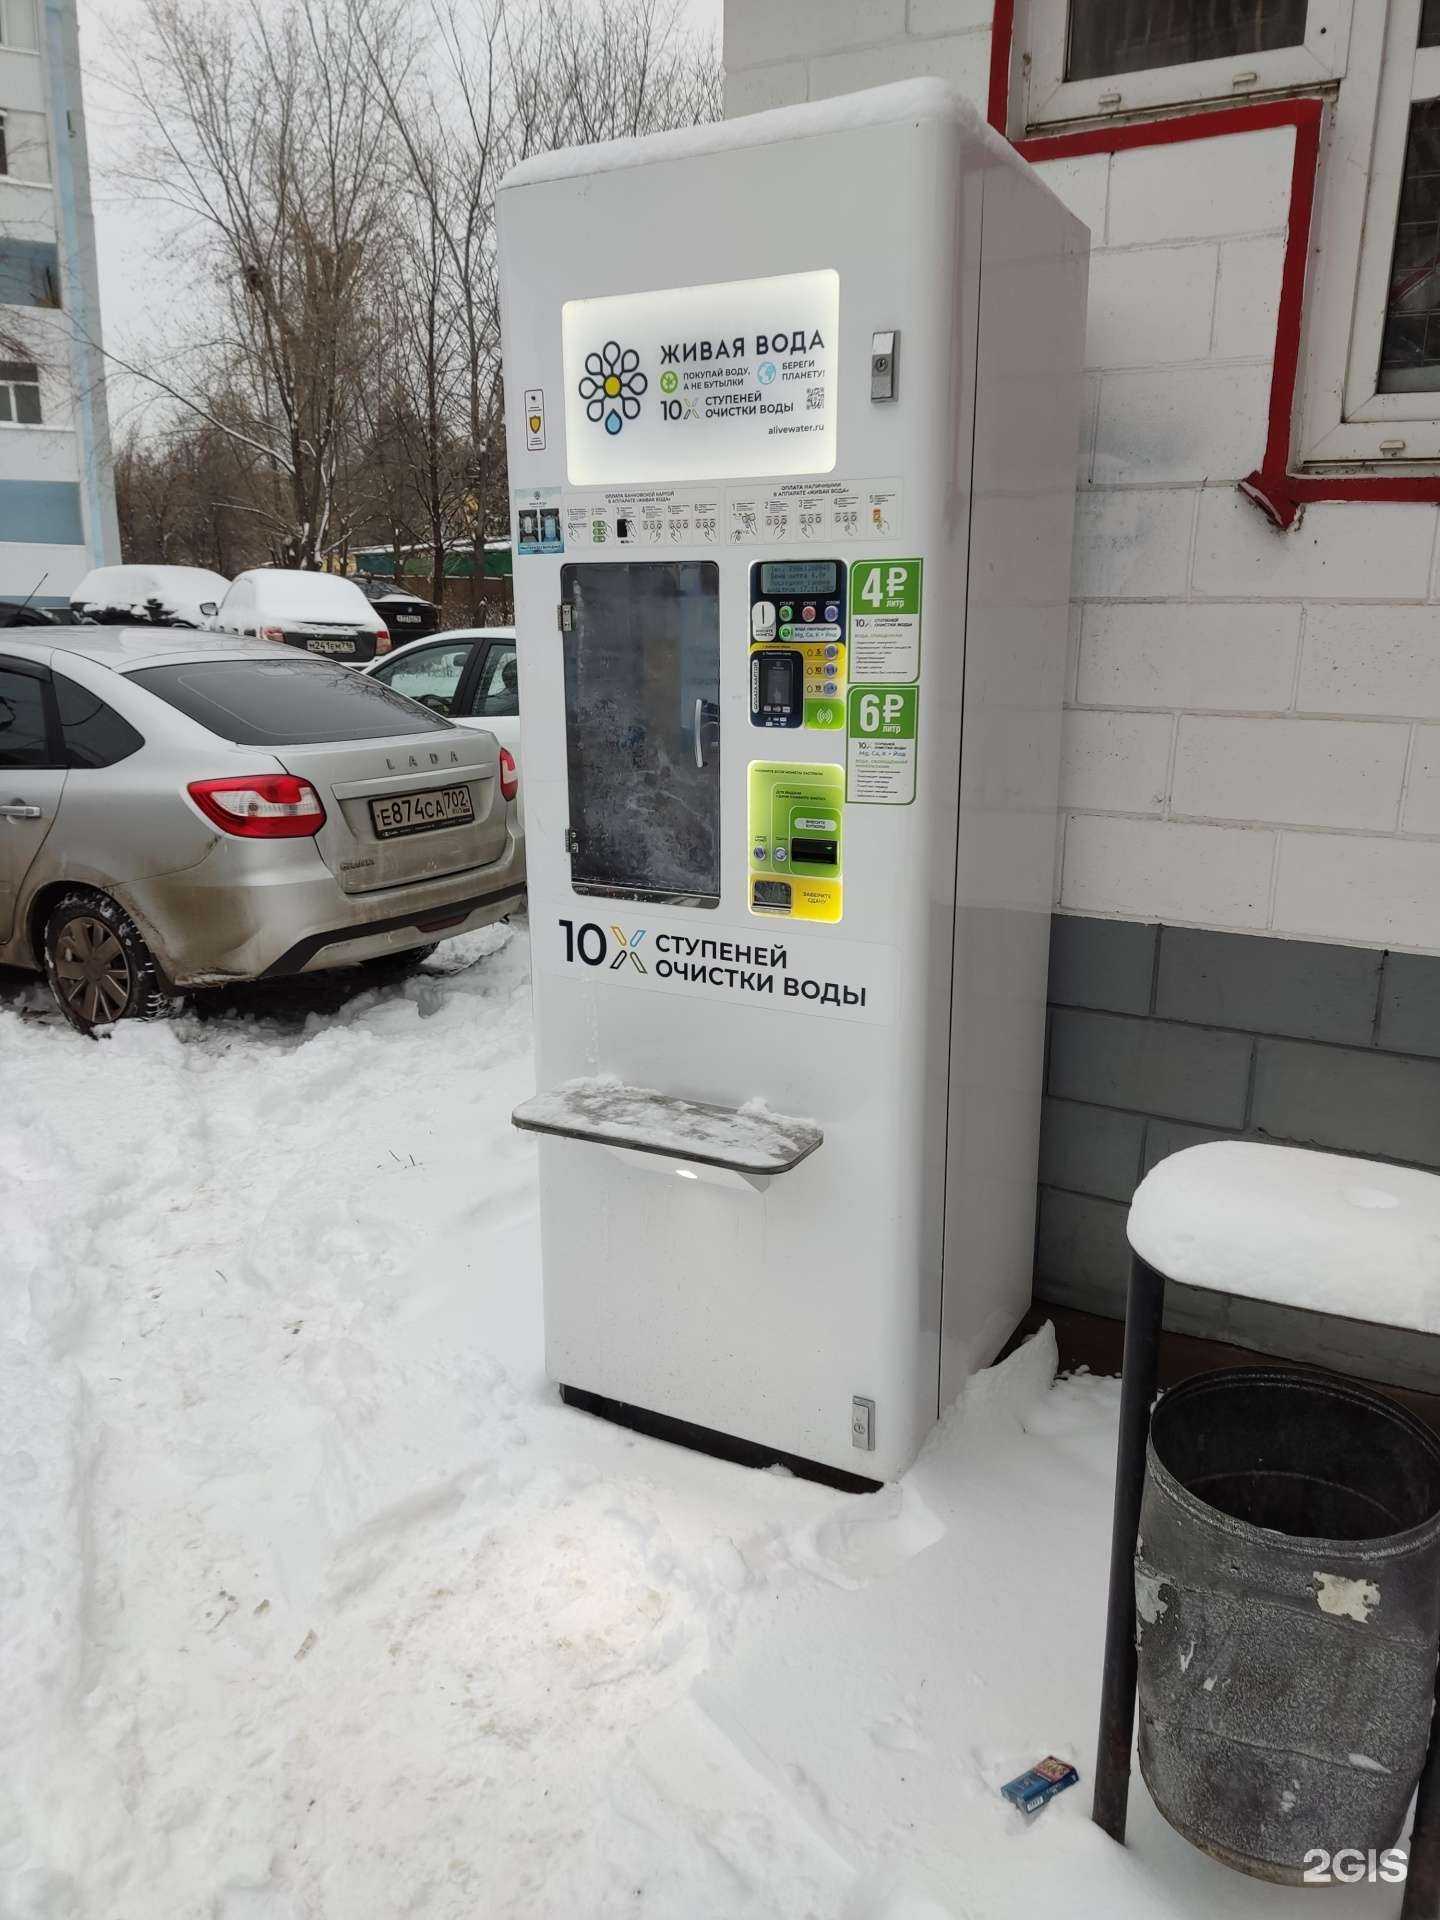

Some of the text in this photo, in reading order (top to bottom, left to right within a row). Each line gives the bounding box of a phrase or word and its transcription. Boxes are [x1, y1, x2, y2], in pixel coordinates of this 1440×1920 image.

[660, 329, 825, 365] ЖИВАЯ ВОДА
[782, 360, 815, 370] БЕРЕГИ
[684, 367, 750, 381] ПОКУПАЙ ВОДУ,
[782, 370, 825, 381] ПЛАНЕТУ!
[684, 379, 744, 391] А НЕ БУТЫЛКИ
[705, 391, 762, 406] СТУПЕНЕЙ
[705, 402, 794, 418] ОЧИСТКИ ВОДЫ
[768, 424, 824, 435] alivewater.ru
[386, 751, 459, 770] LADA
[655, 934, 788, 969] СТУПЕНЕЙ
[655, 959, 867, 1007] ОЧИСТКИ ВОДЫ
